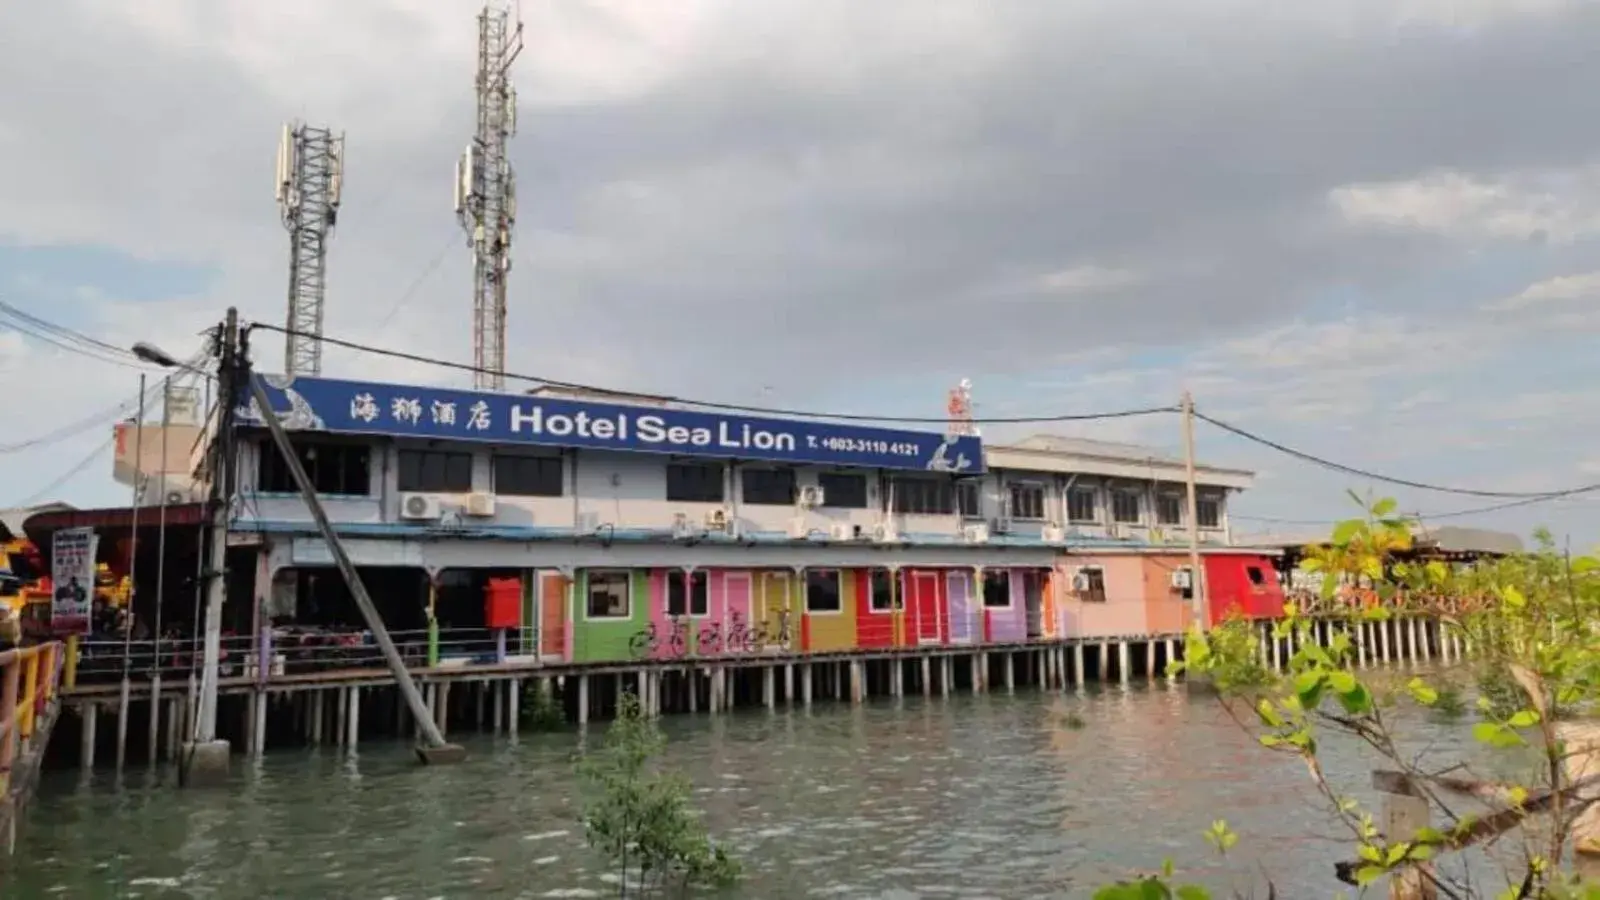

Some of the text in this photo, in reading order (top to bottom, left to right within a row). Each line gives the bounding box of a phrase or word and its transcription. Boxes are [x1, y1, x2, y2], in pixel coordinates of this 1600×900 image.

[510, 404, 795, 451] Hotel Sea Lion
[890, 442, 919, 455] 4121
